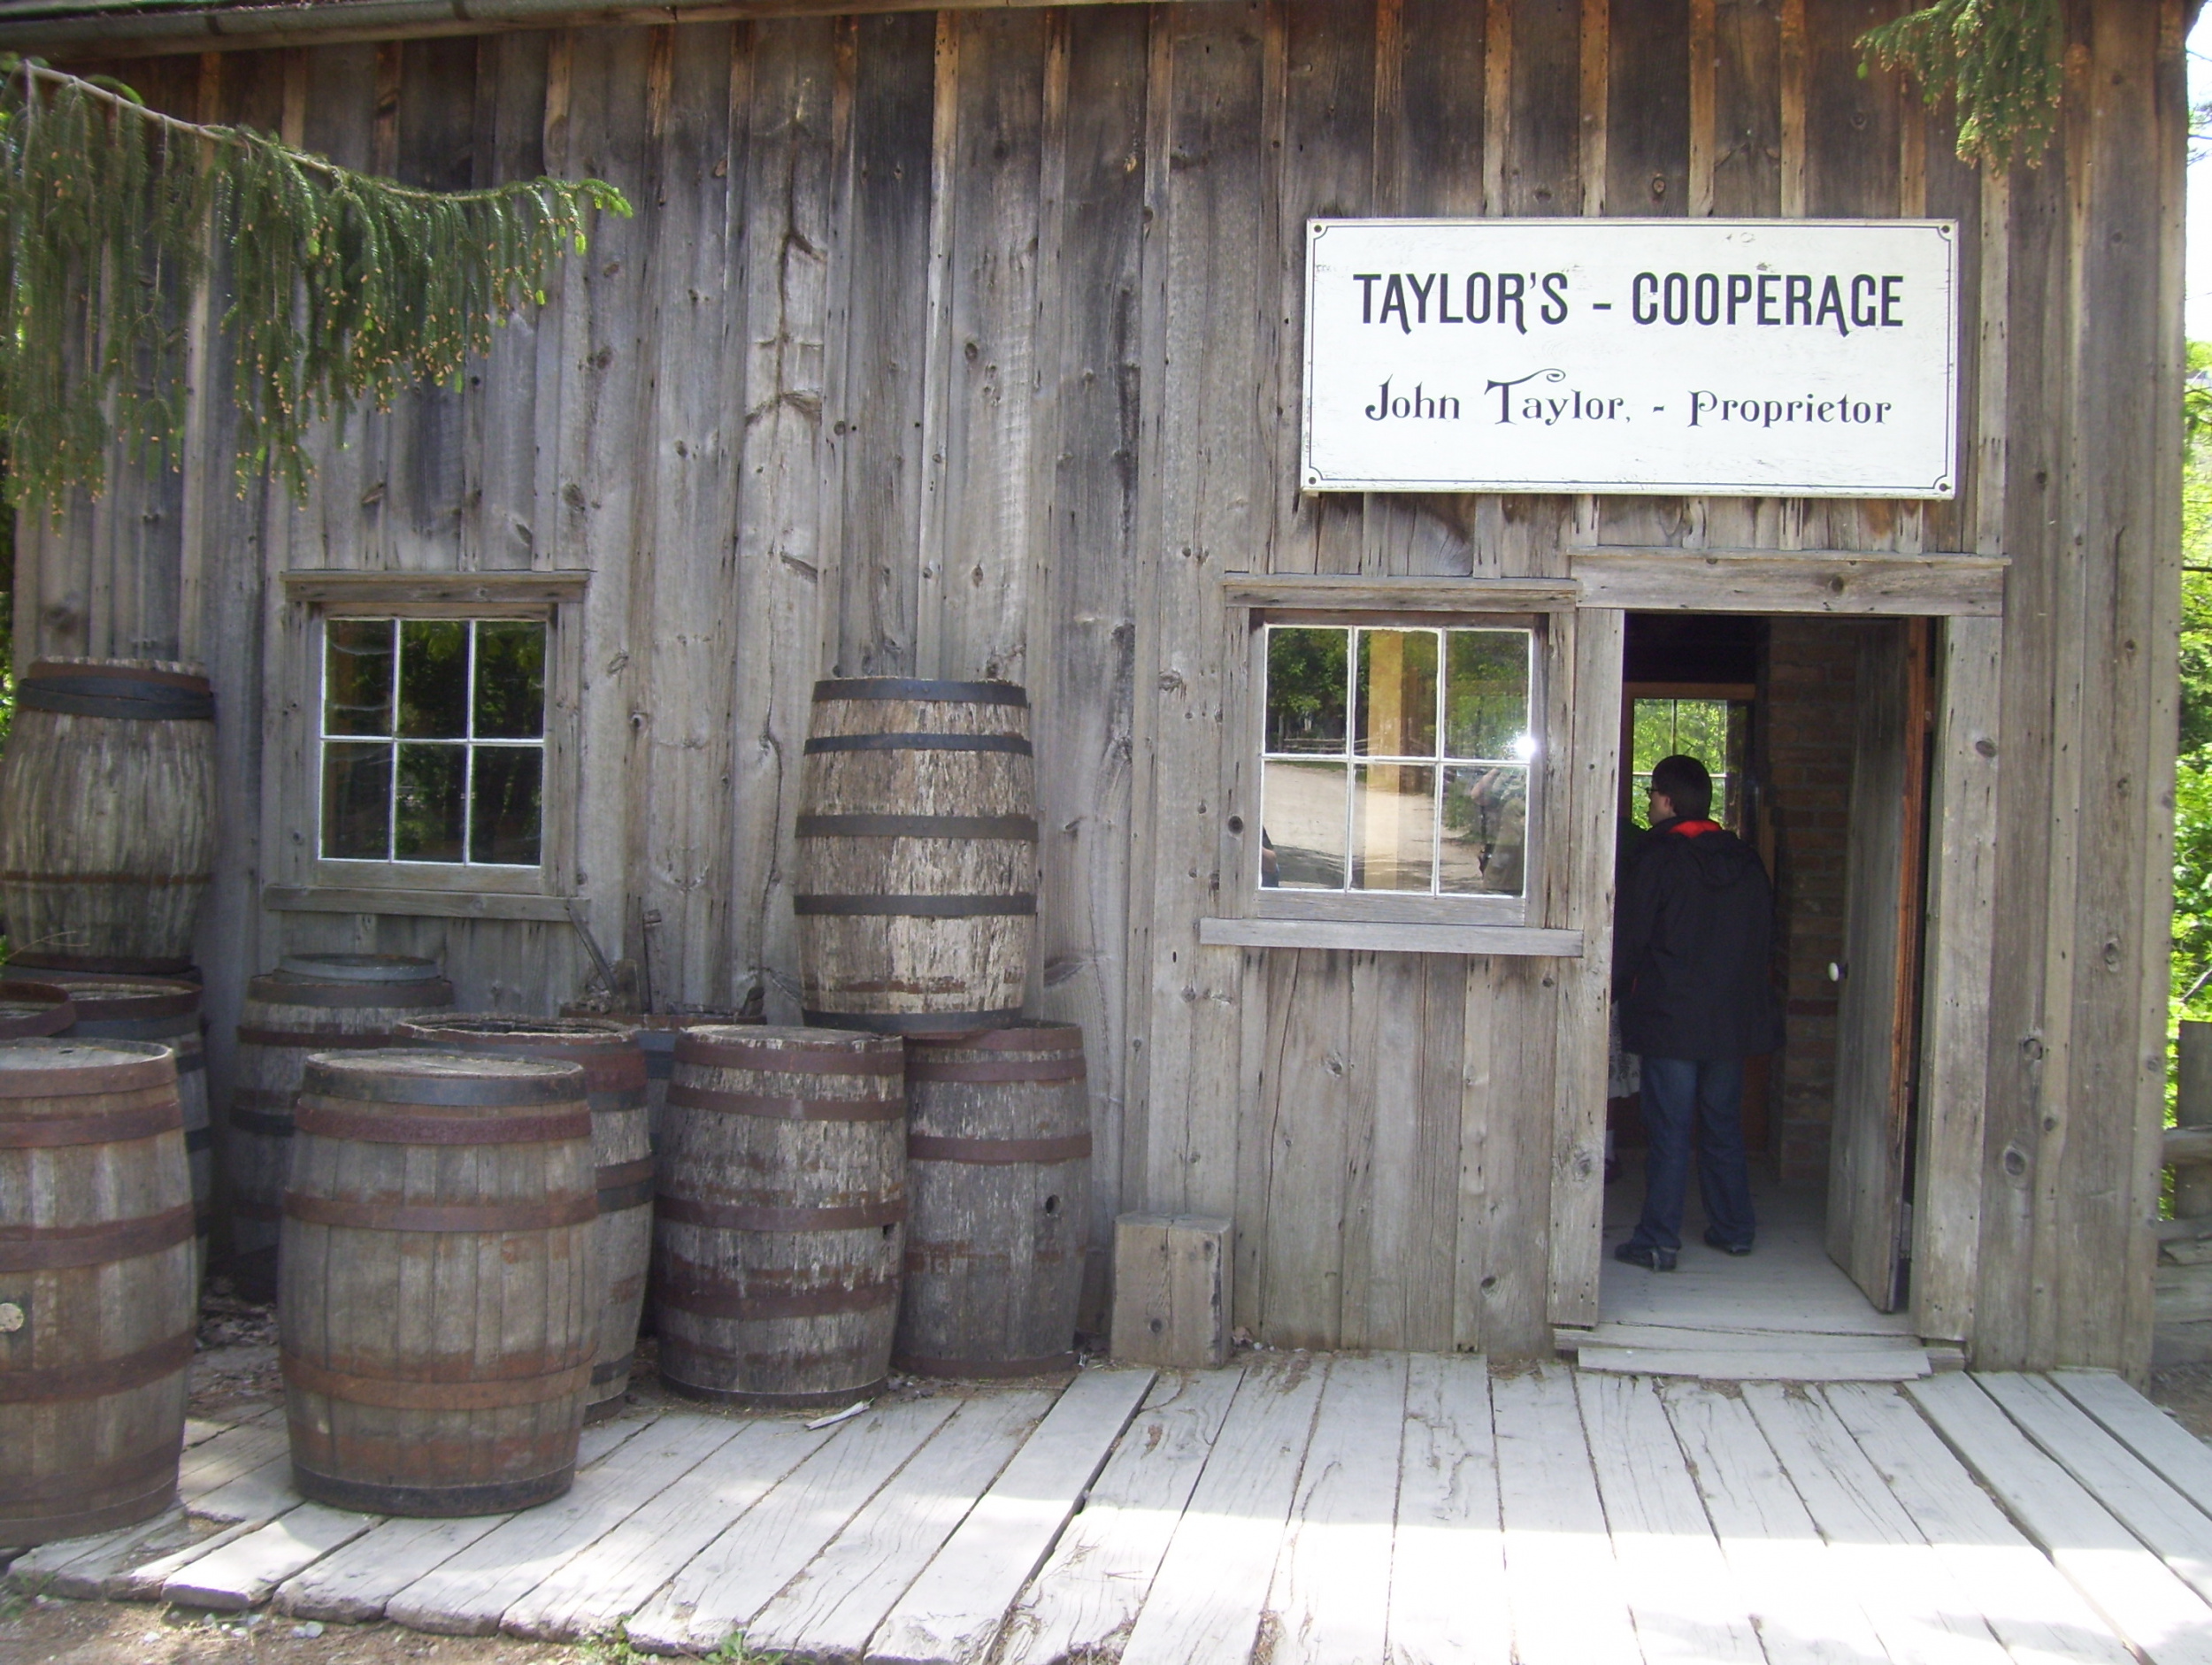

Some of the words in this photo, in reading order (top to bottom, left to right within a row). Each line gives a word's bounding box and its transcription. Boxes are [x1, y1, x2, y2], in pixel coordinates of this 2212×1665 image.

[1353, 272, 1568, 335] TAYLOR'S
[1632, 271, 1904, 337] COOPERAGE
[1365, 373, 1460, 422] John
[1687, 390, 1892, 428] Proprietor
